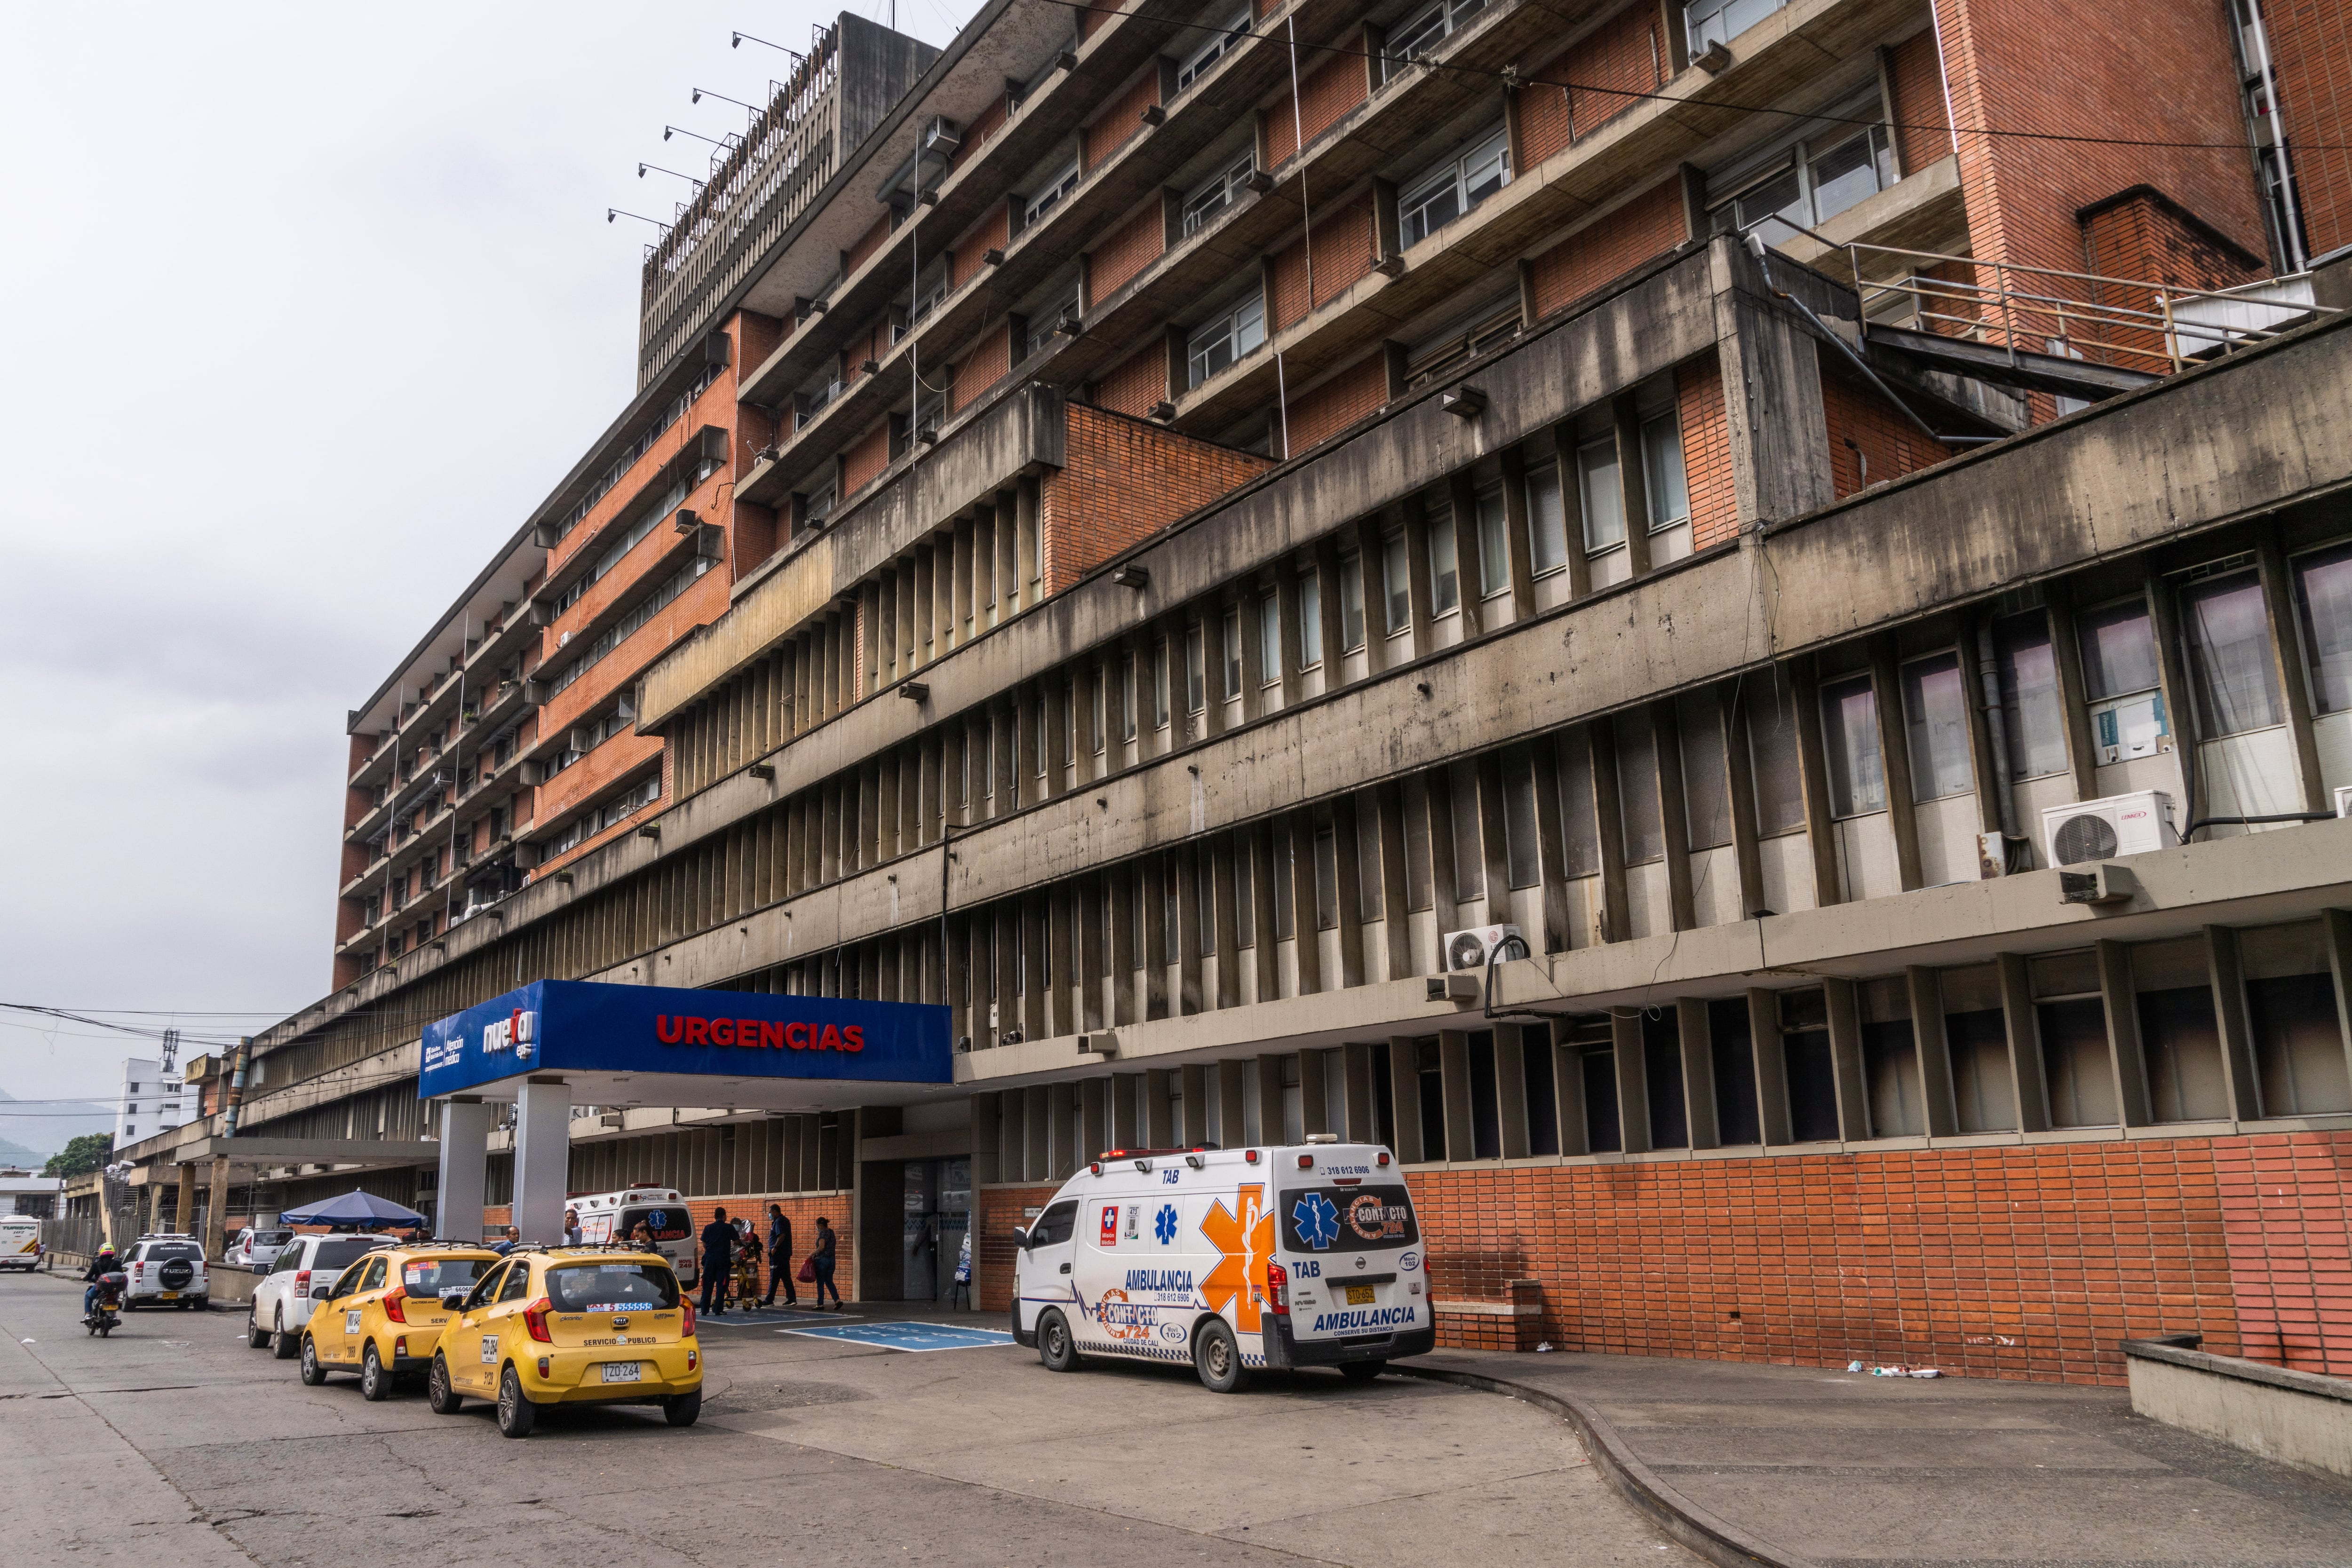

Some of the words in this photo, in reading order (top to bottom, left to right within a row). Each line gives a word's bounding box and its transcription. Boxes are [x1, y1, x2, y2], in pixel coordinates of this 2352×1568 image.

[484, 1009, 532, 1053] nueva
[656, 1014, 865, 1052] URGENCIAS
[446, 1035, 463, 1053] Atención
[516, 1044, 530, 1059] eps
[445, 1051, 460, 1067] médica
[1163, 1170, 1179, 1184] TAB
[1349, 1196, 1376, 1238] AMBULANCIAS
[1381, 1221, 1404, 1233] 724
[1292, 1261, 1320, 1278] TAB
[1125, 1270, 1193, 1292] AMBULANCIA
[1177, 1293, 1189, 1302] 6906
[1101, 1289, 1120, 1338] AMBULANCIAS
[1313, 1307, 1415, 1331] AMBULANCIA
[1126, 1325, 1150, 1339] 724
